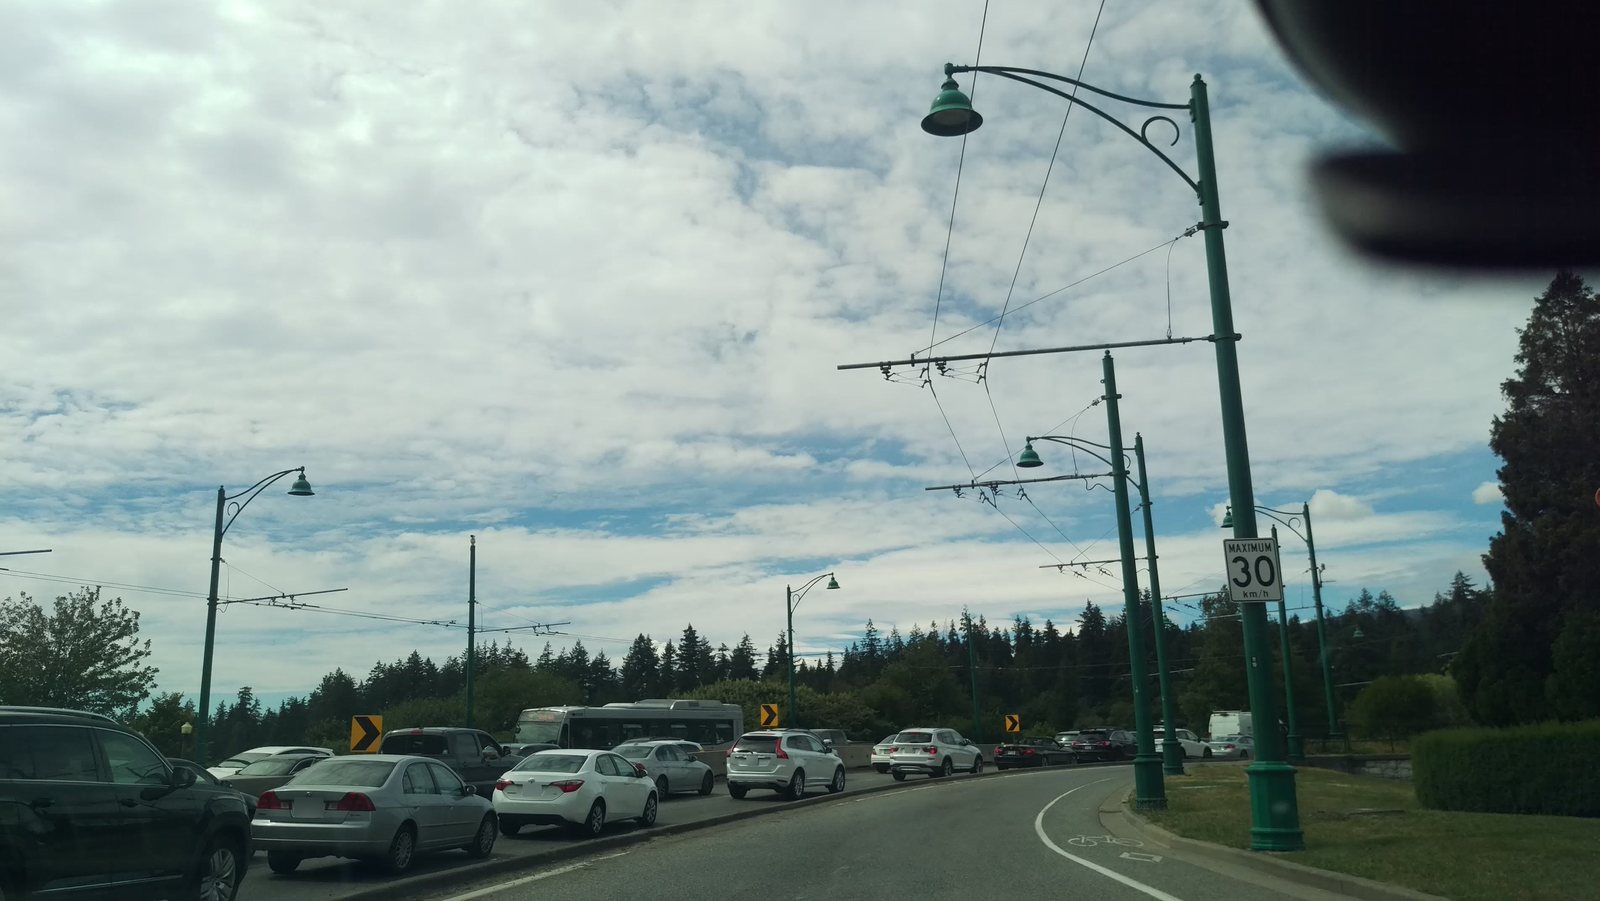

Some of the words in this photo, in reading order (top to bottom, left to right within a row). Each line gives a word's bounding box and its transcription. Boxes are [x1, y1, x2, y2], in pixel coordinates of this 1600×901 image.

[1229, 543, 1272, 552] MAXIMUM
[1232, 555, 1275, 587] 30
[1243, 590, 1269, 598] km/h
